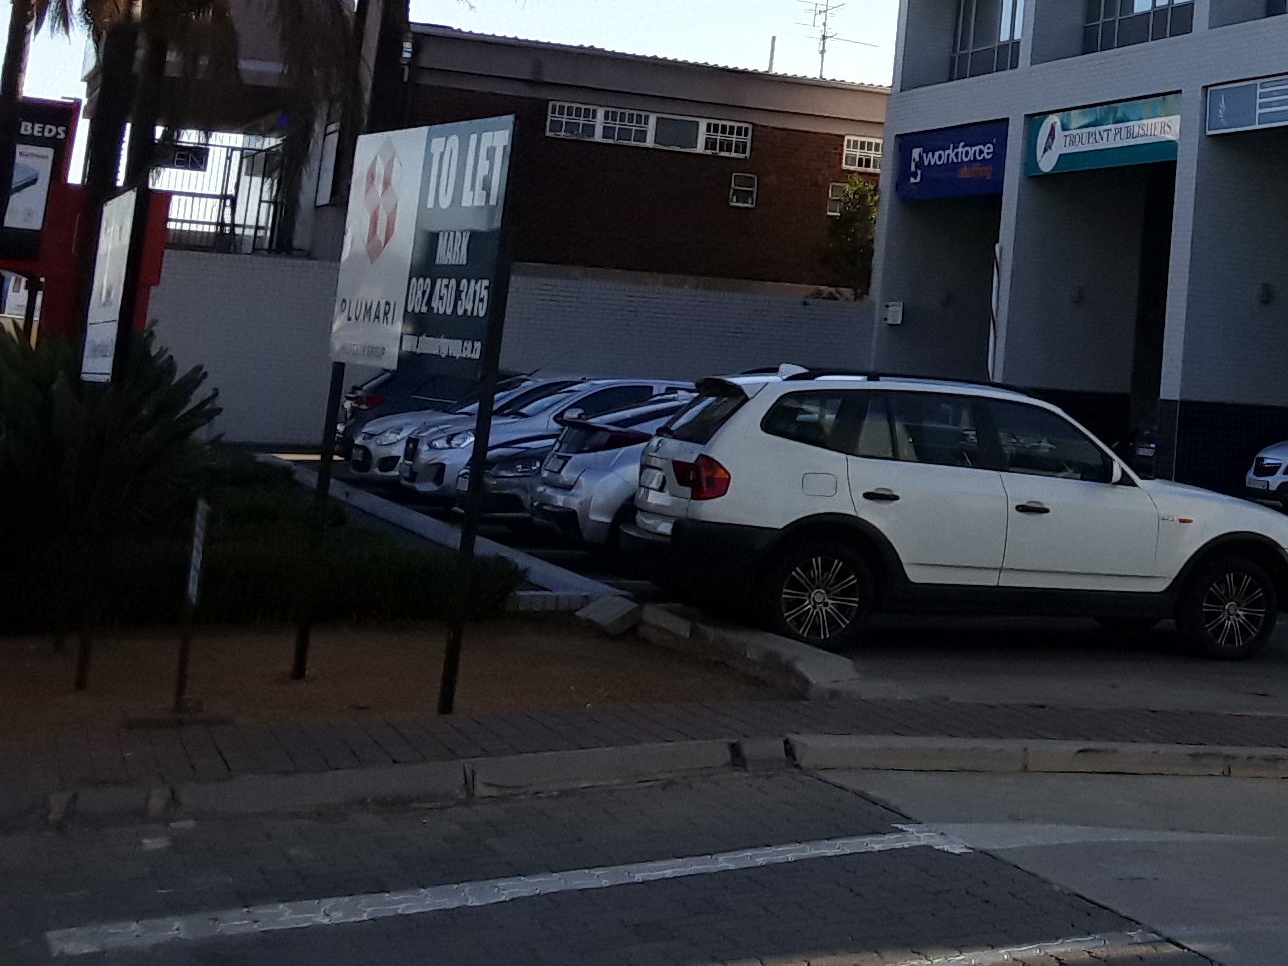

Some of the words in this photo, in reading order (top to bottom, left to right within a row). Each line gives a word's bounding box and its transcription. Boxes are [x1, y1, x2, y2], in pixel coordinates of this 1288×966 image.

[19, 120, 67, 140] BEDS
[1063, 128, 1112, 148] TROUPANT
[1113, 119, 1173, 142] PUBLISHERS
[922, 141, 994, 167] workforce
[427, 135, 458, 210] TO
[461, 129, 510, 207] LET
[435, 230, 471, 265] MARK
[340, 298, 397, 325] PLUMARI
[407, 276, 432, 313] 082
[431, 277, 457, 316] 450
[456, 278, 490, 318] 3415
